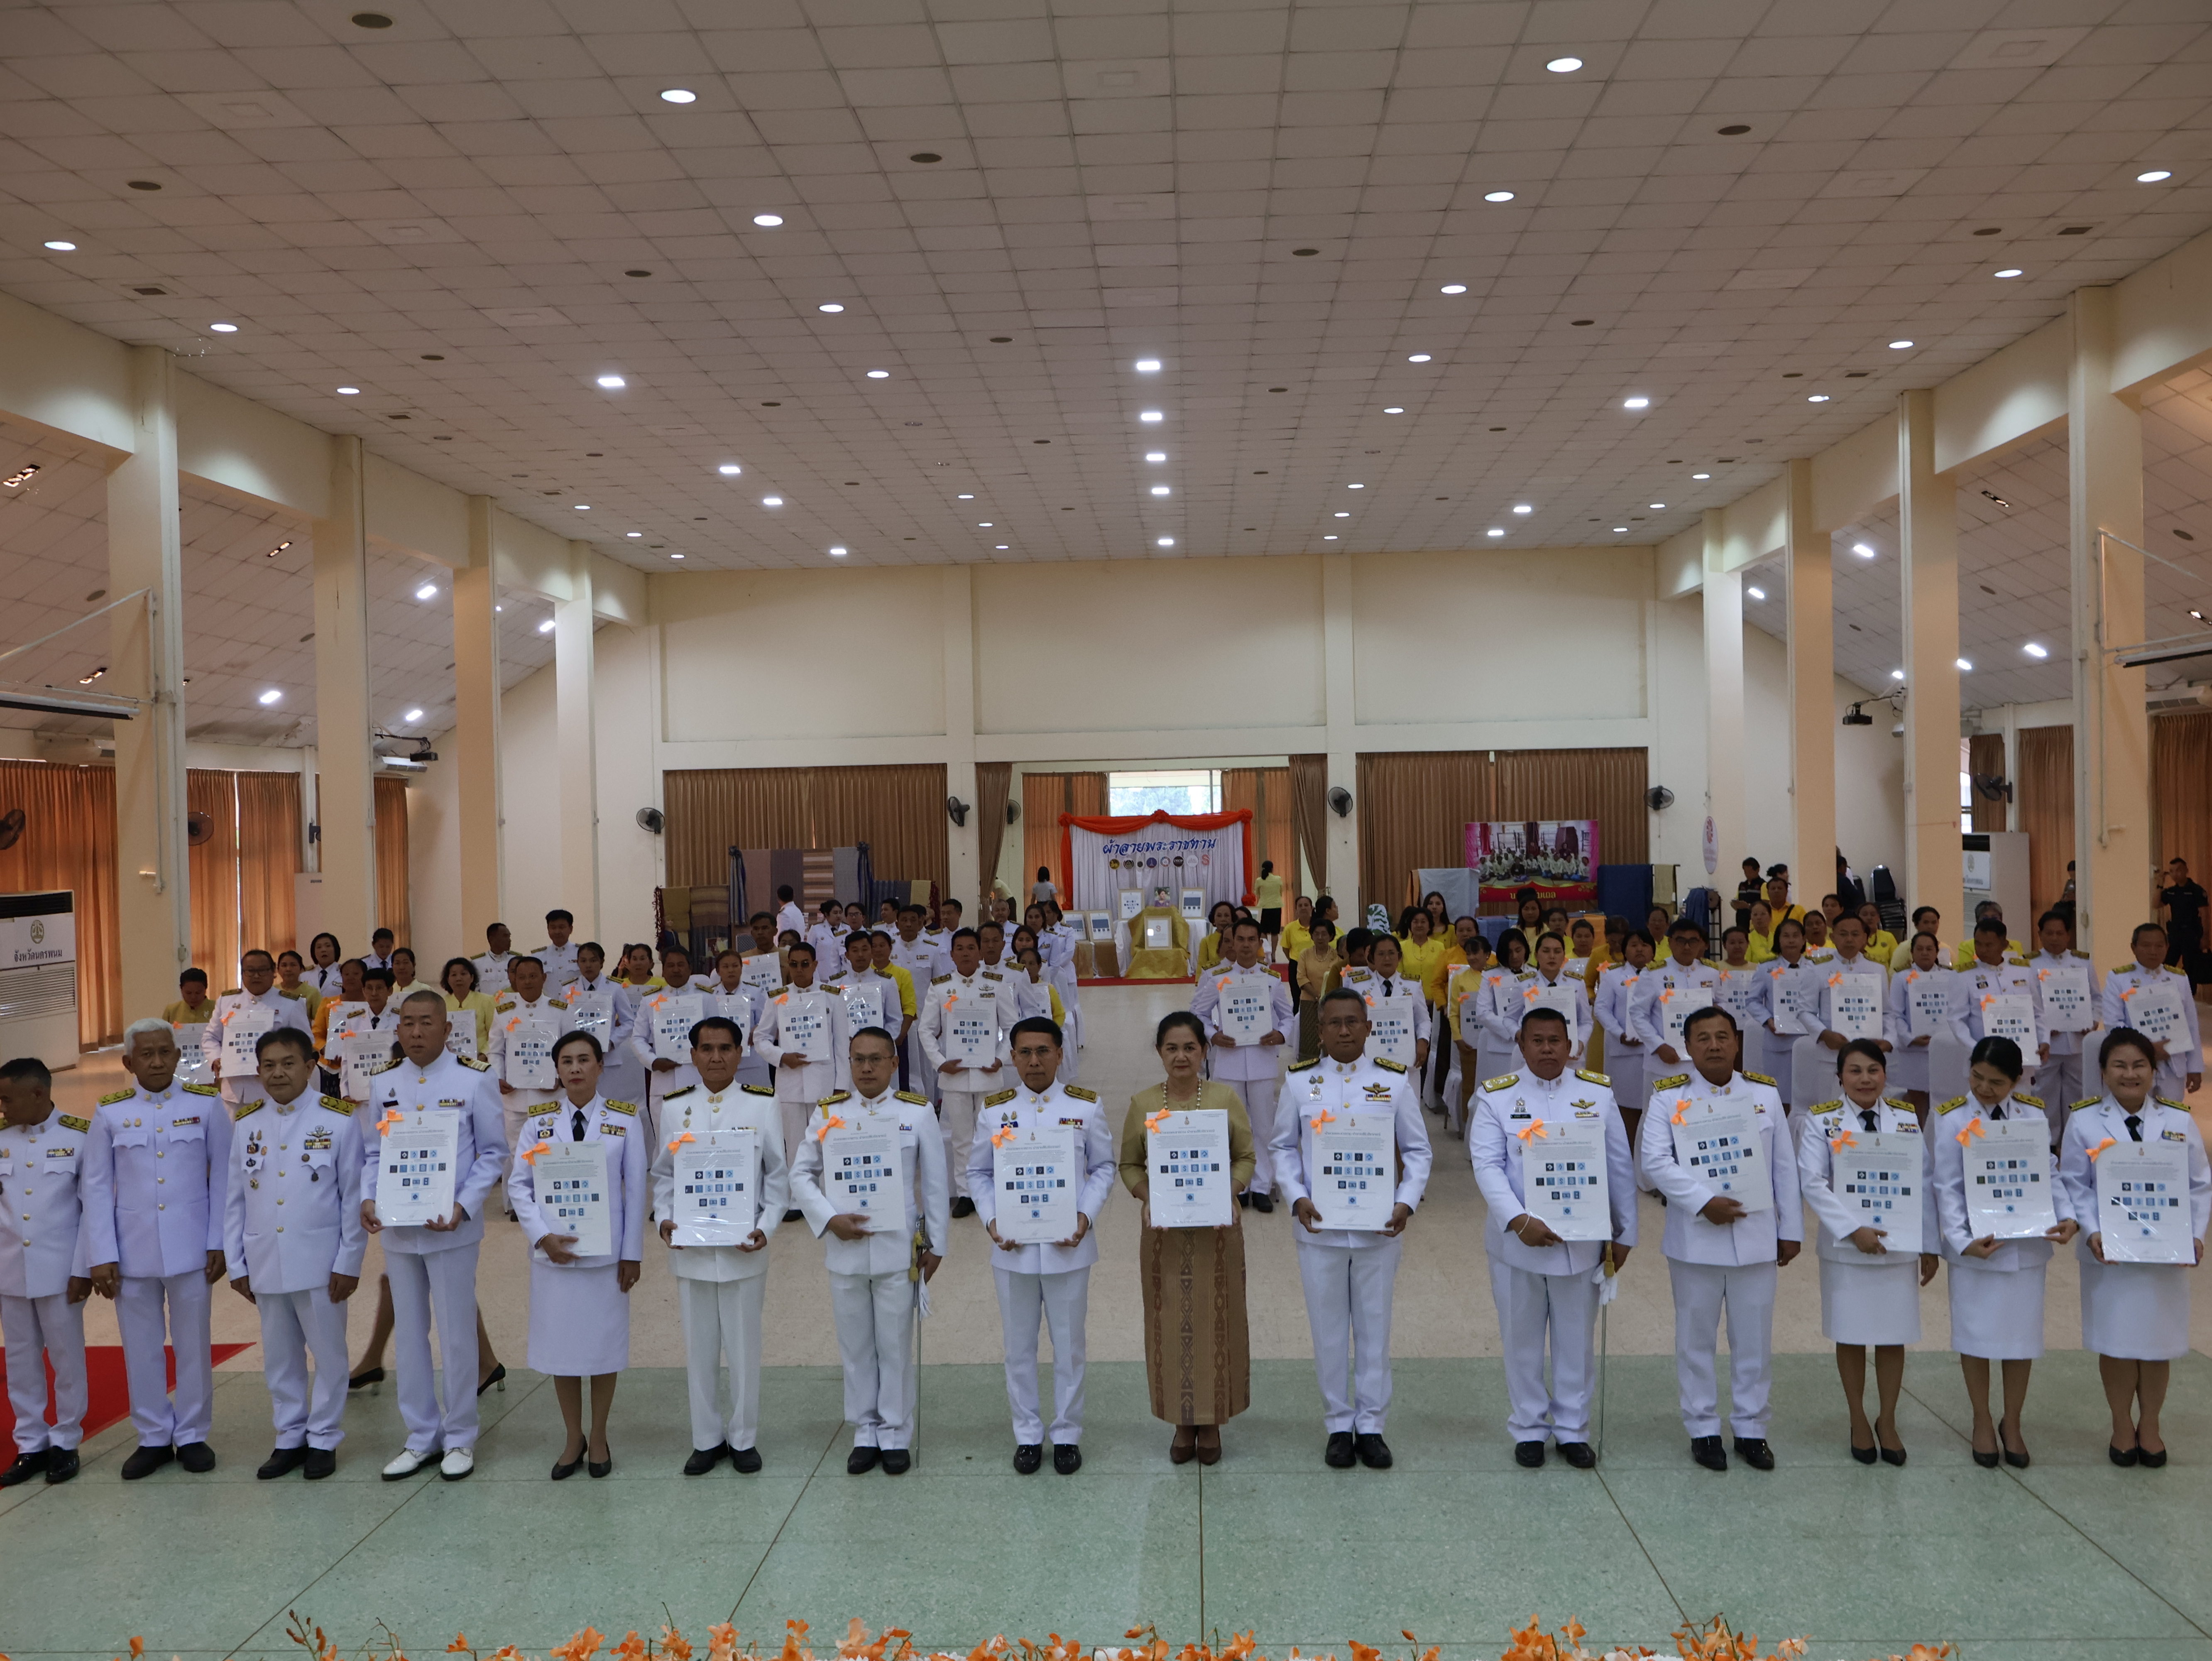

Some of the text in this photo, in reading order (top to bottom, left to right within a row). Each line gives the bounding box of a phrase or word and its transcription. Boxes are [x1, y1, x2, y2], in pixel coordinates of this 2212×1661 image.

[1103, 838, 1216, 855] ผ้าลายพระราชทาน
[14, 948, 62, 962] จังหวัดนครพนม
